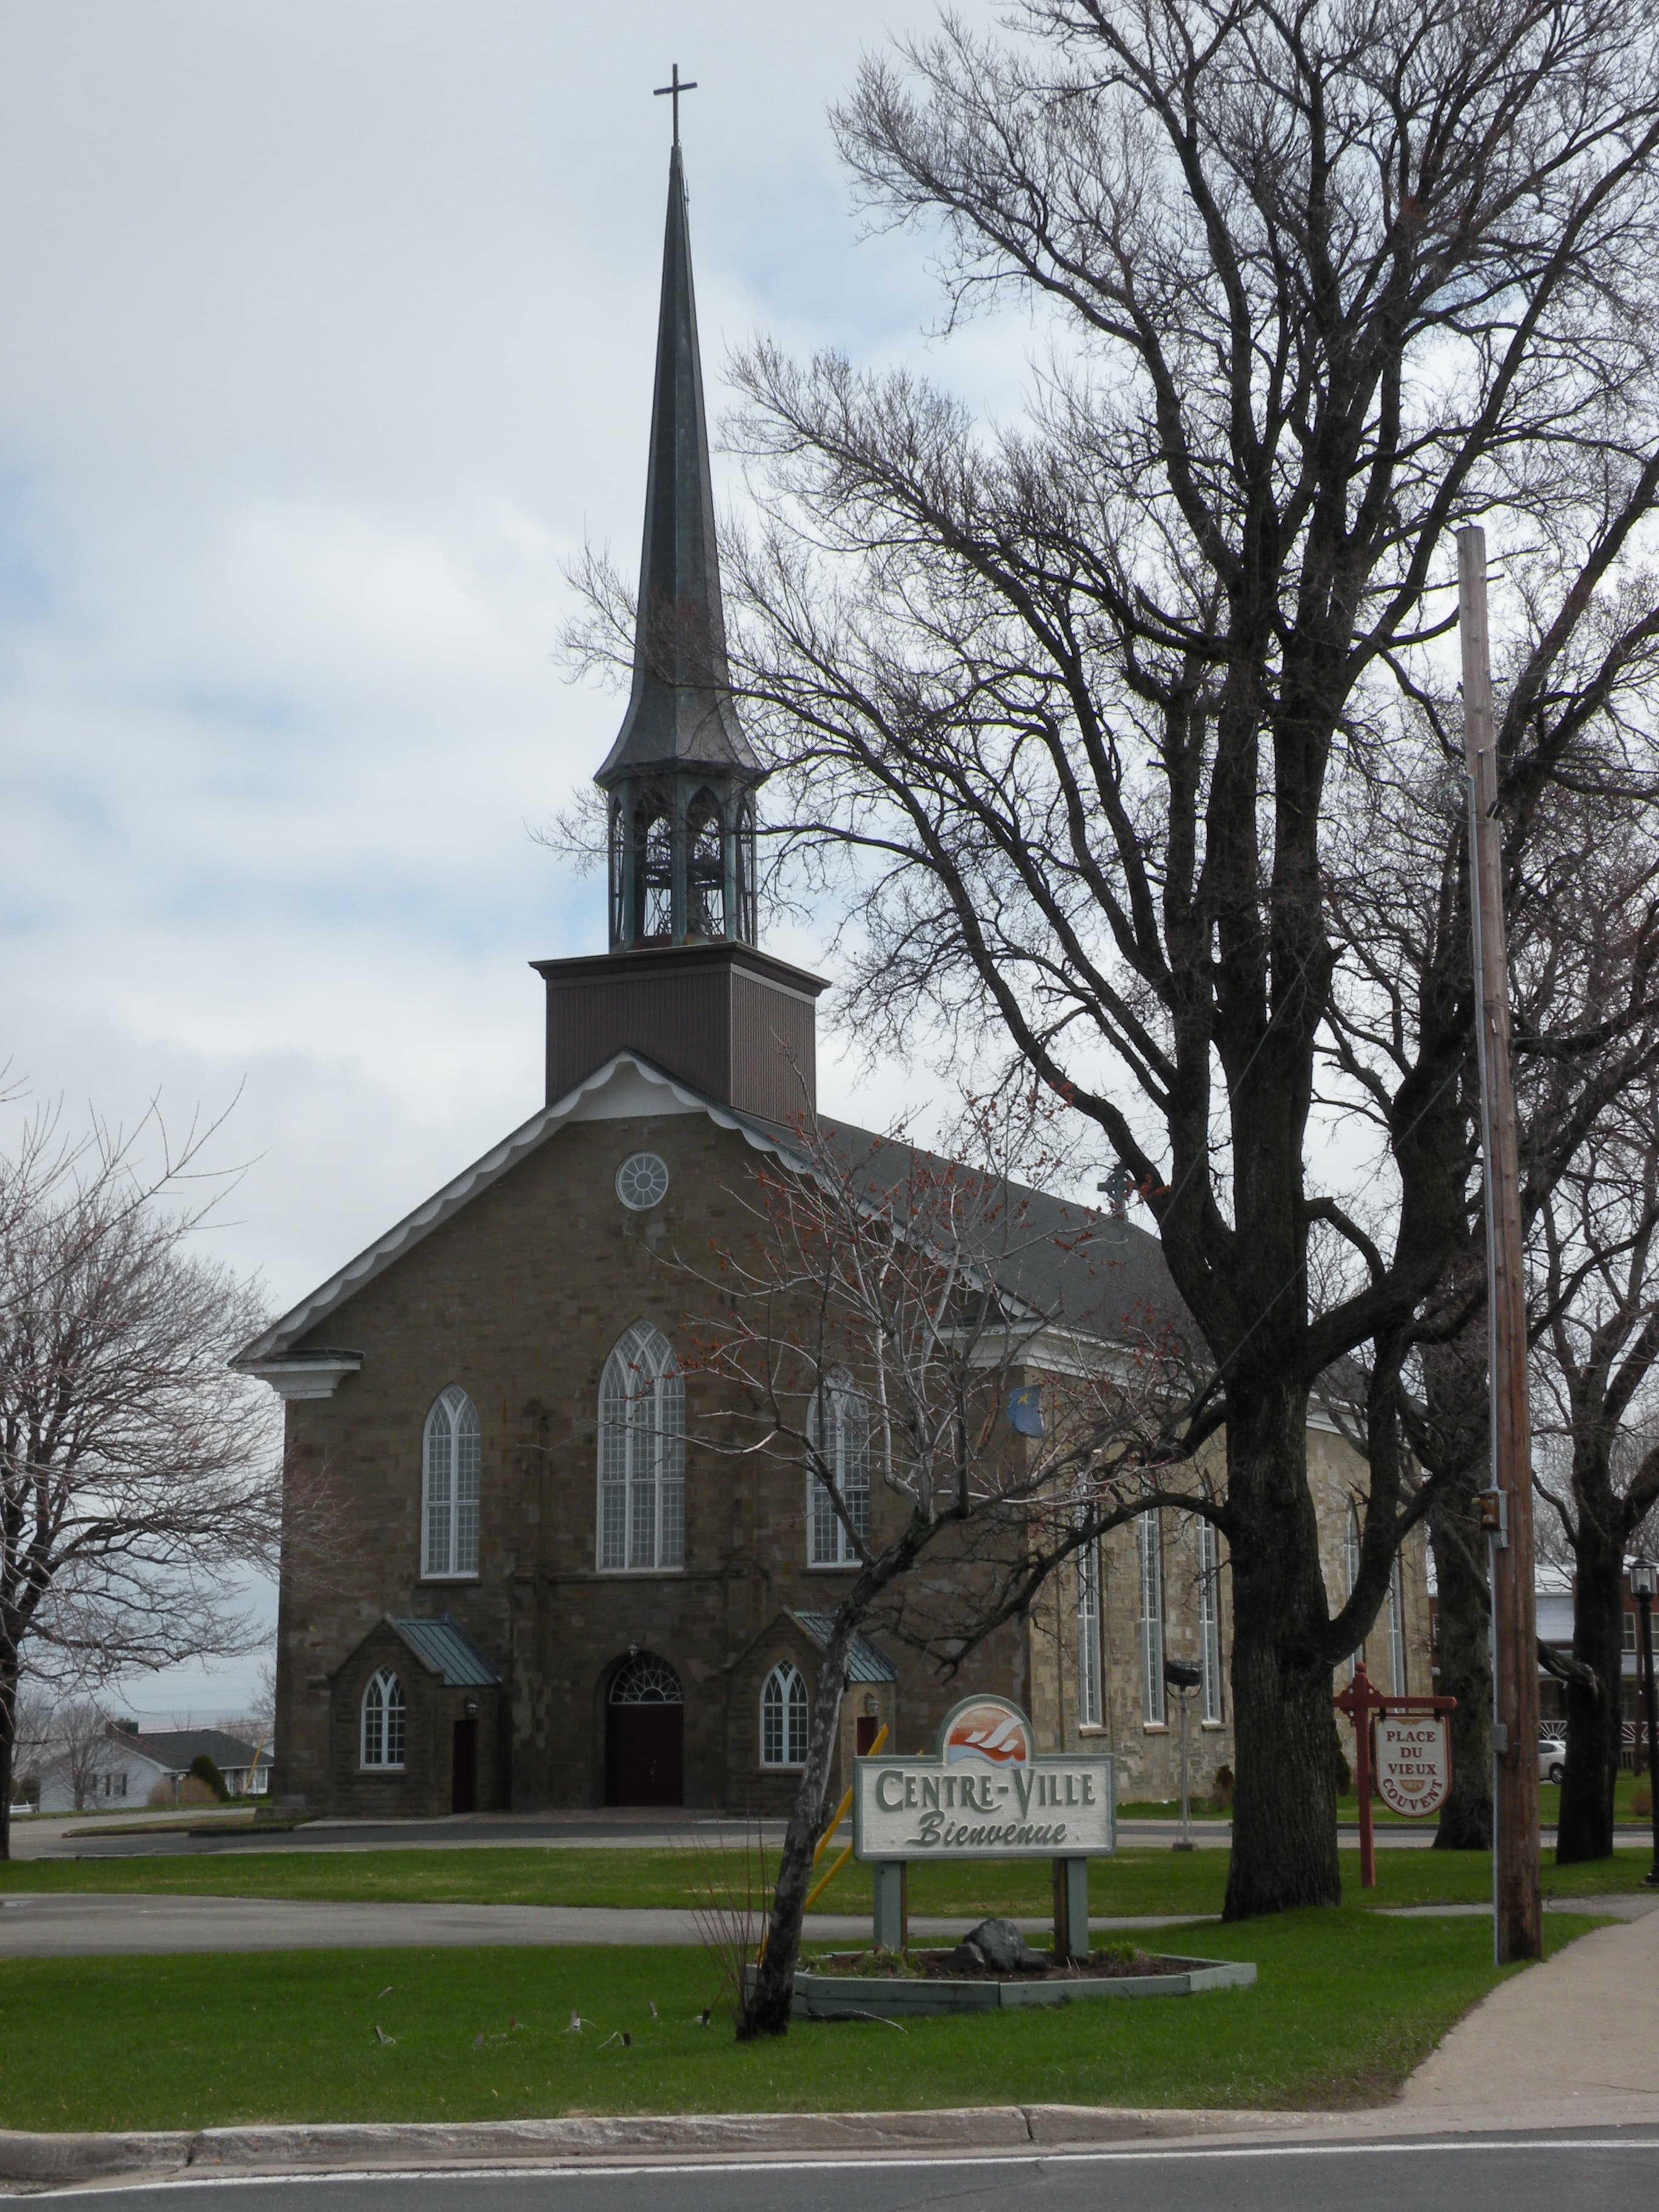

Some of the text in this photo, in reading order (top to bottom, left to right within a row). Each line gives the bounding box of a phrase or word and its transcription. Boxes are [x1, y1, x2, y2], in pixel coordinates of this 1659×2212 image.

[1387, 1731, 1436, 1742] PLACE
[1400, 1747, 1423, 1758] DU
[1388, 1763, 1437, 1775] VIEUX
[876, 1769, 1096, 1819] CENTRE-VILLE
[1383, 1778, 1443, 1811] COUVENT
[907, 1809, 1067, 1847] Bienvenue
